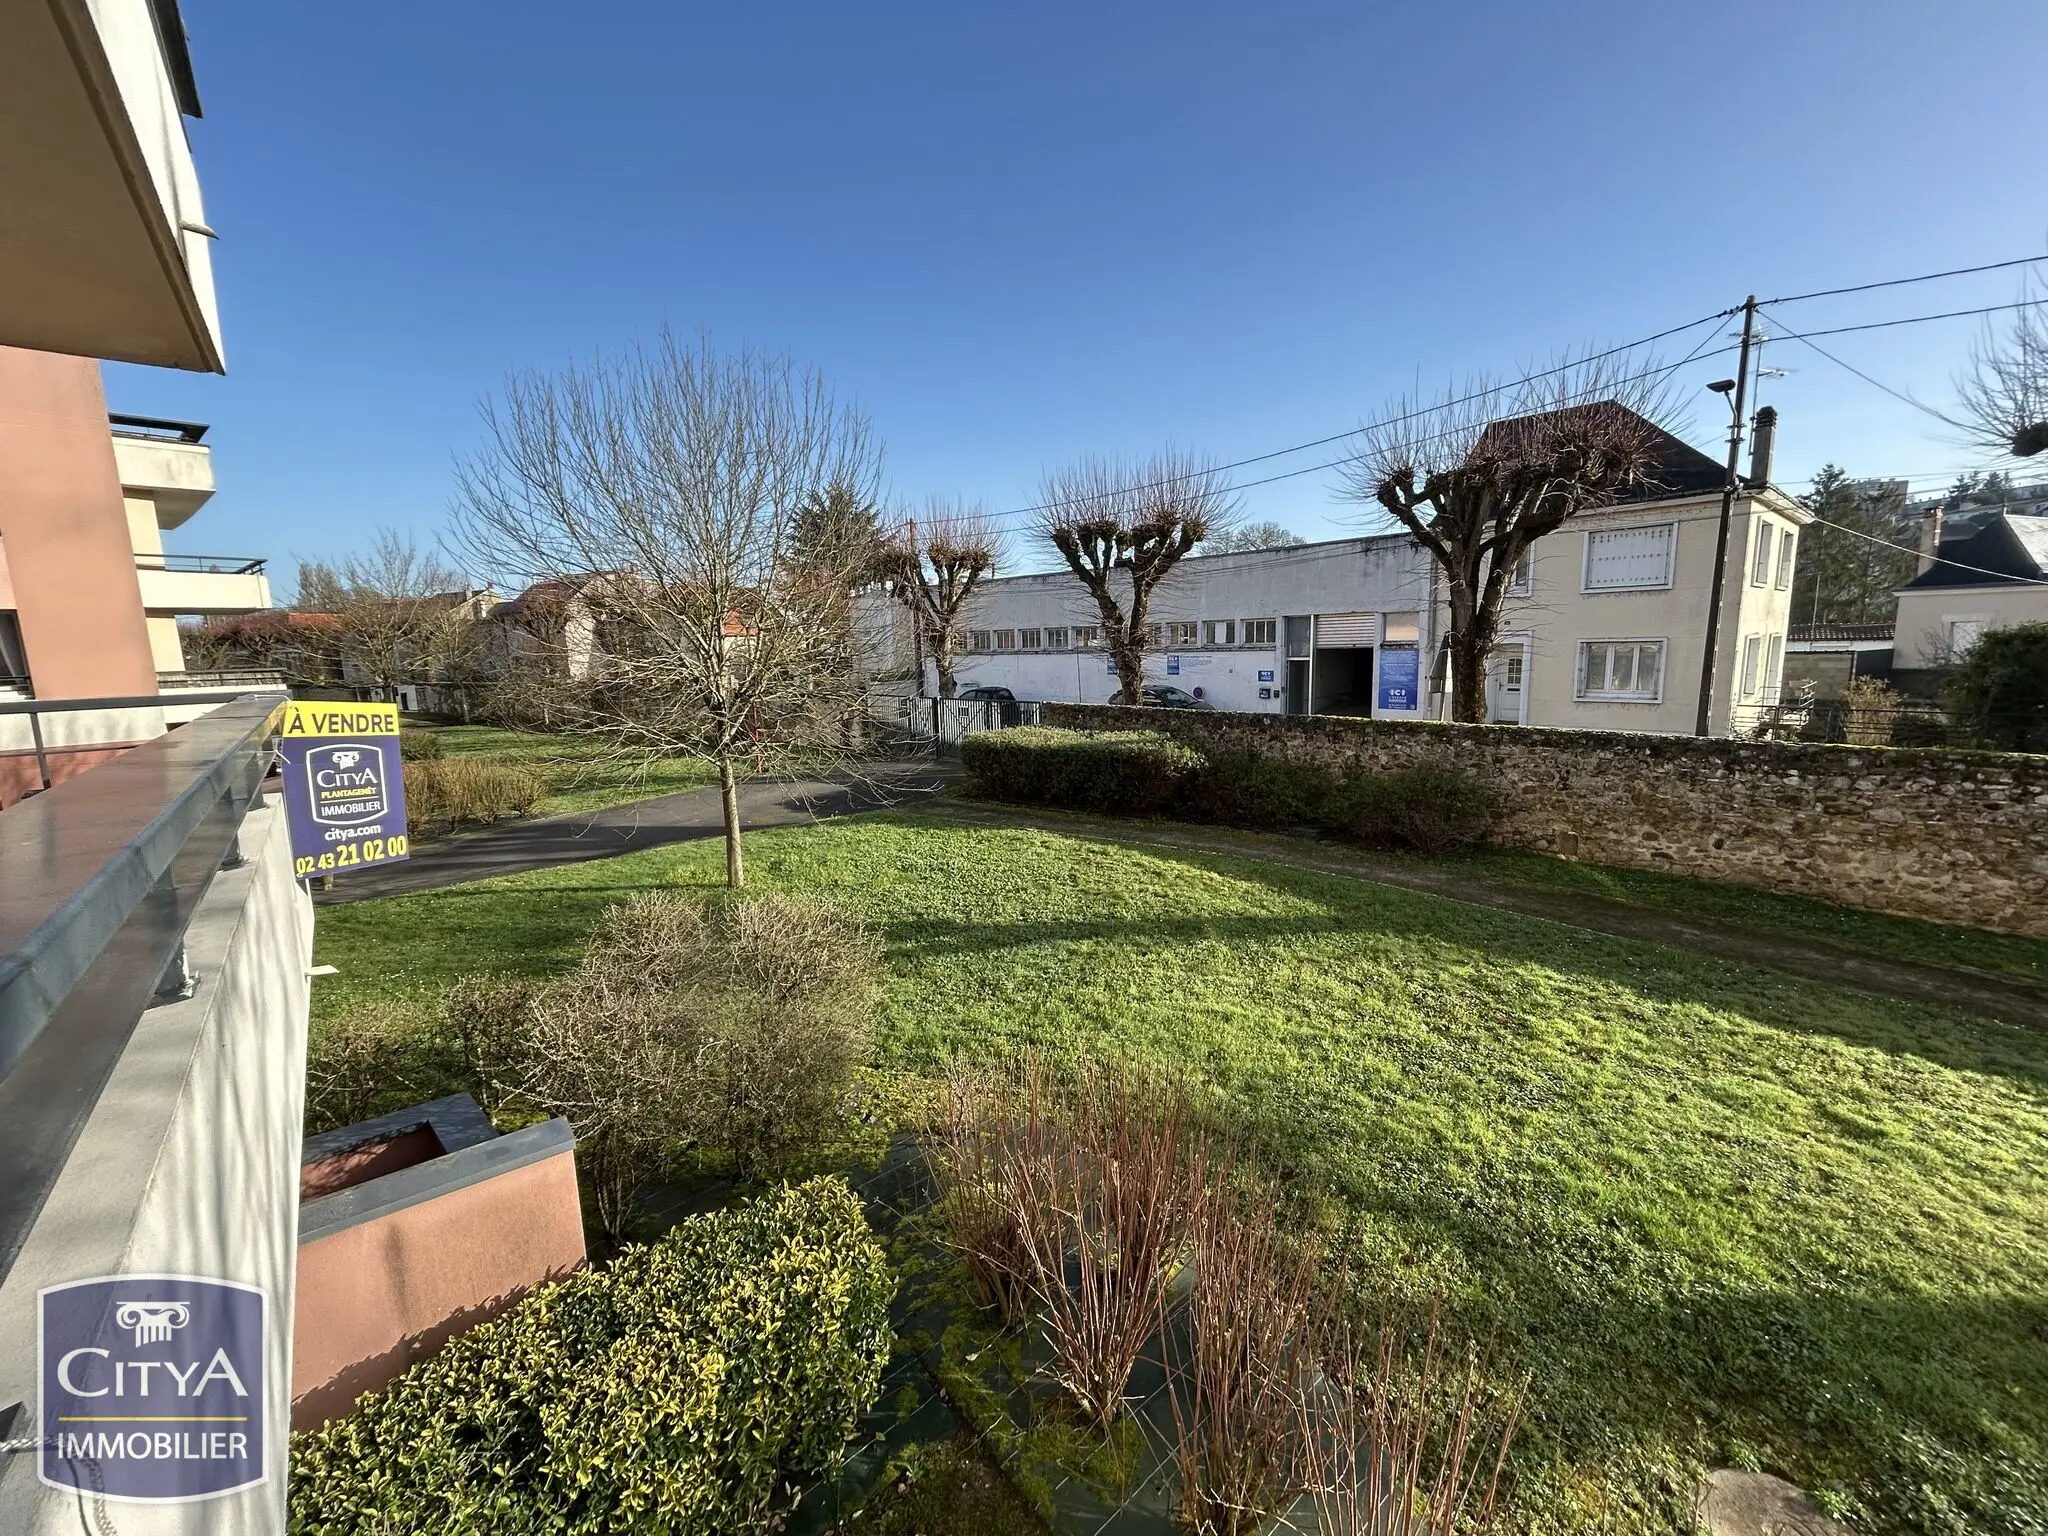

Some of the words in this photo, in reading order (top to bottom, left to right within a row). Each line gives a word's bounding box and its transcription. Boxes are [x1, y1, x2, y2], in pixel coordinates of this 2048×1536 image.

[288, 707, 305, 734] À
[311, 713, 394, 734] VENDRE
[321, 801, 381, 817] IMMOBILIER
[324, 824, 381, 841] citya.com
[296, 856, 315, 874] 02
[317, 853, 335, 870] 43
[336, 843, 360, 867] 21
[363, 839, 384, 862] 02
[388, 836, 407, 857] 00
